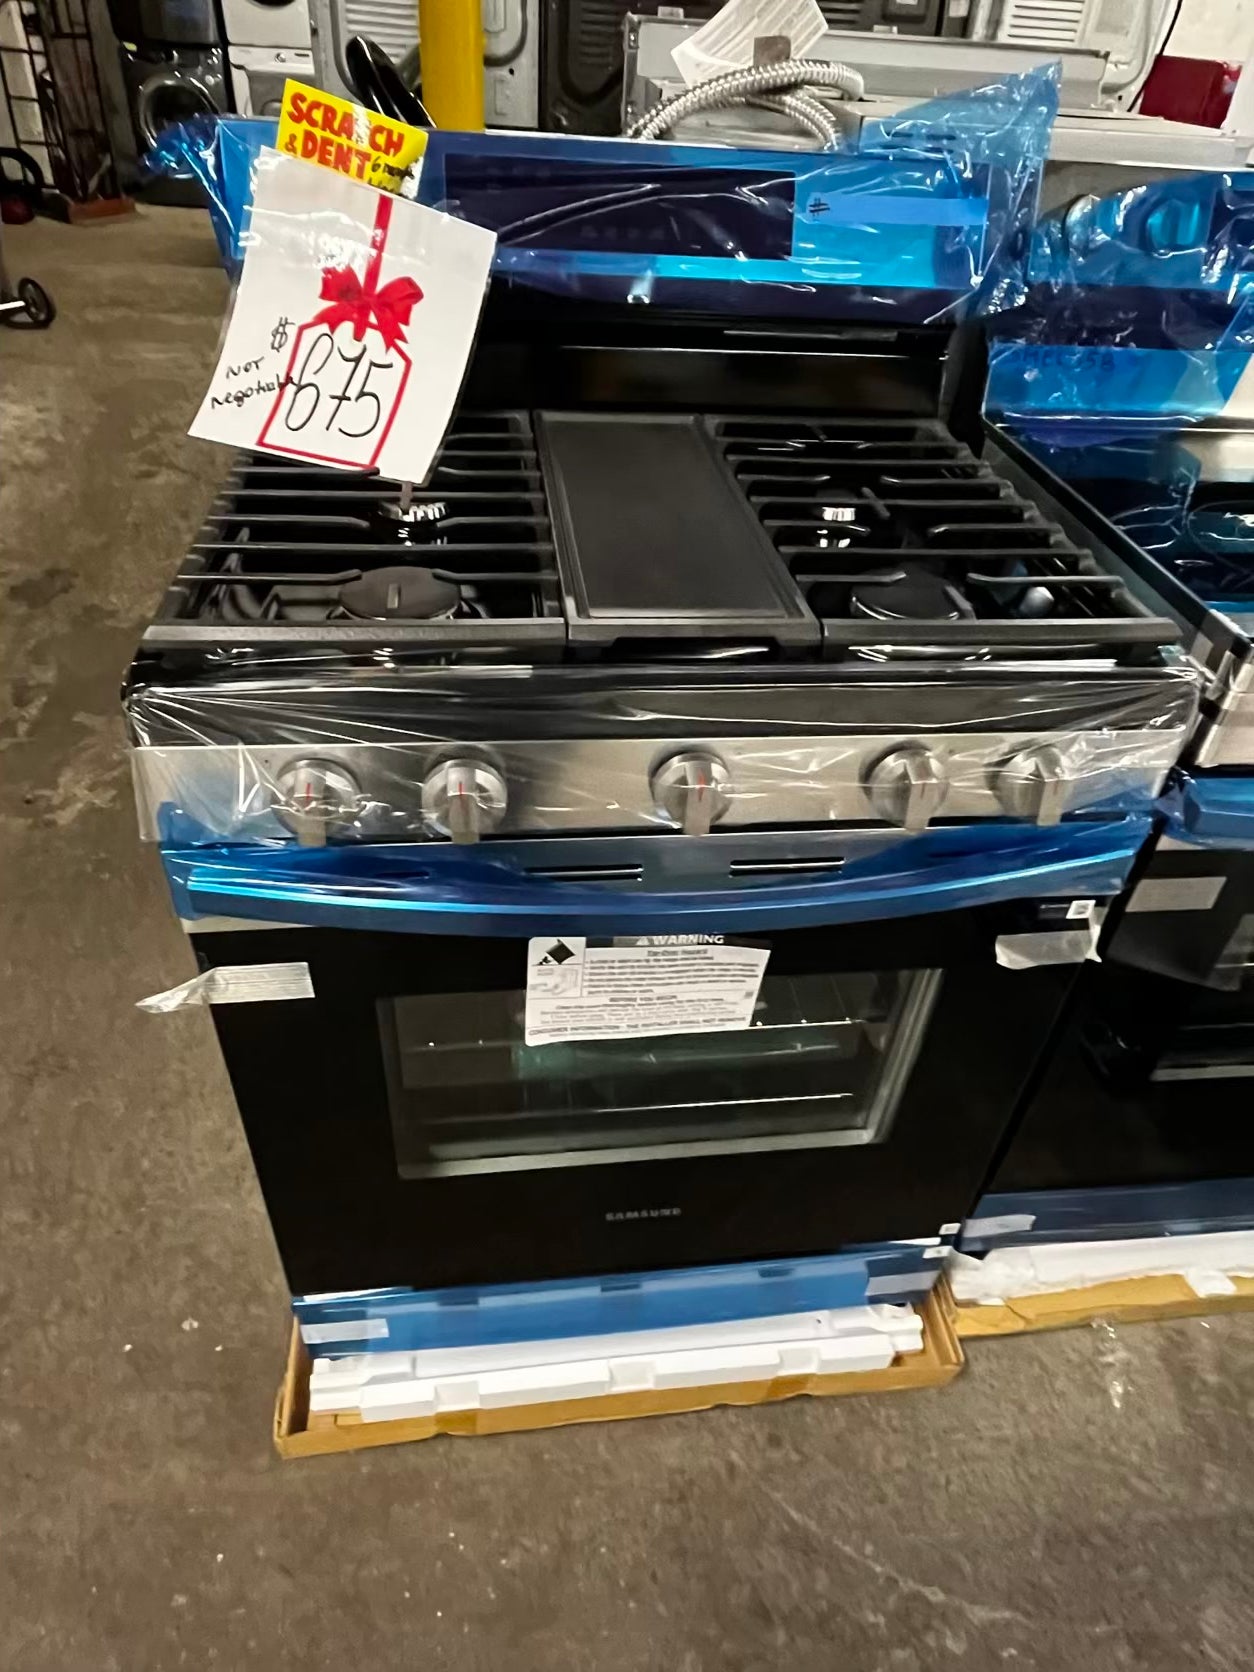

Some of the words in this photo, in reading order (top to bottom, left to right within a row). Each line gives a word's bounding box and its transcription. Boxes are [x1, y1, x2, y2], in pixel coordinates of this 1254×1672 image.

[286, 92, 404, 157] SCRACH
[284, 133, 298, 155] &
[301, 129, 372, 180] DENT
[285, 332, 394, 438] 675
[652, 934, 725, 946] WARNING
